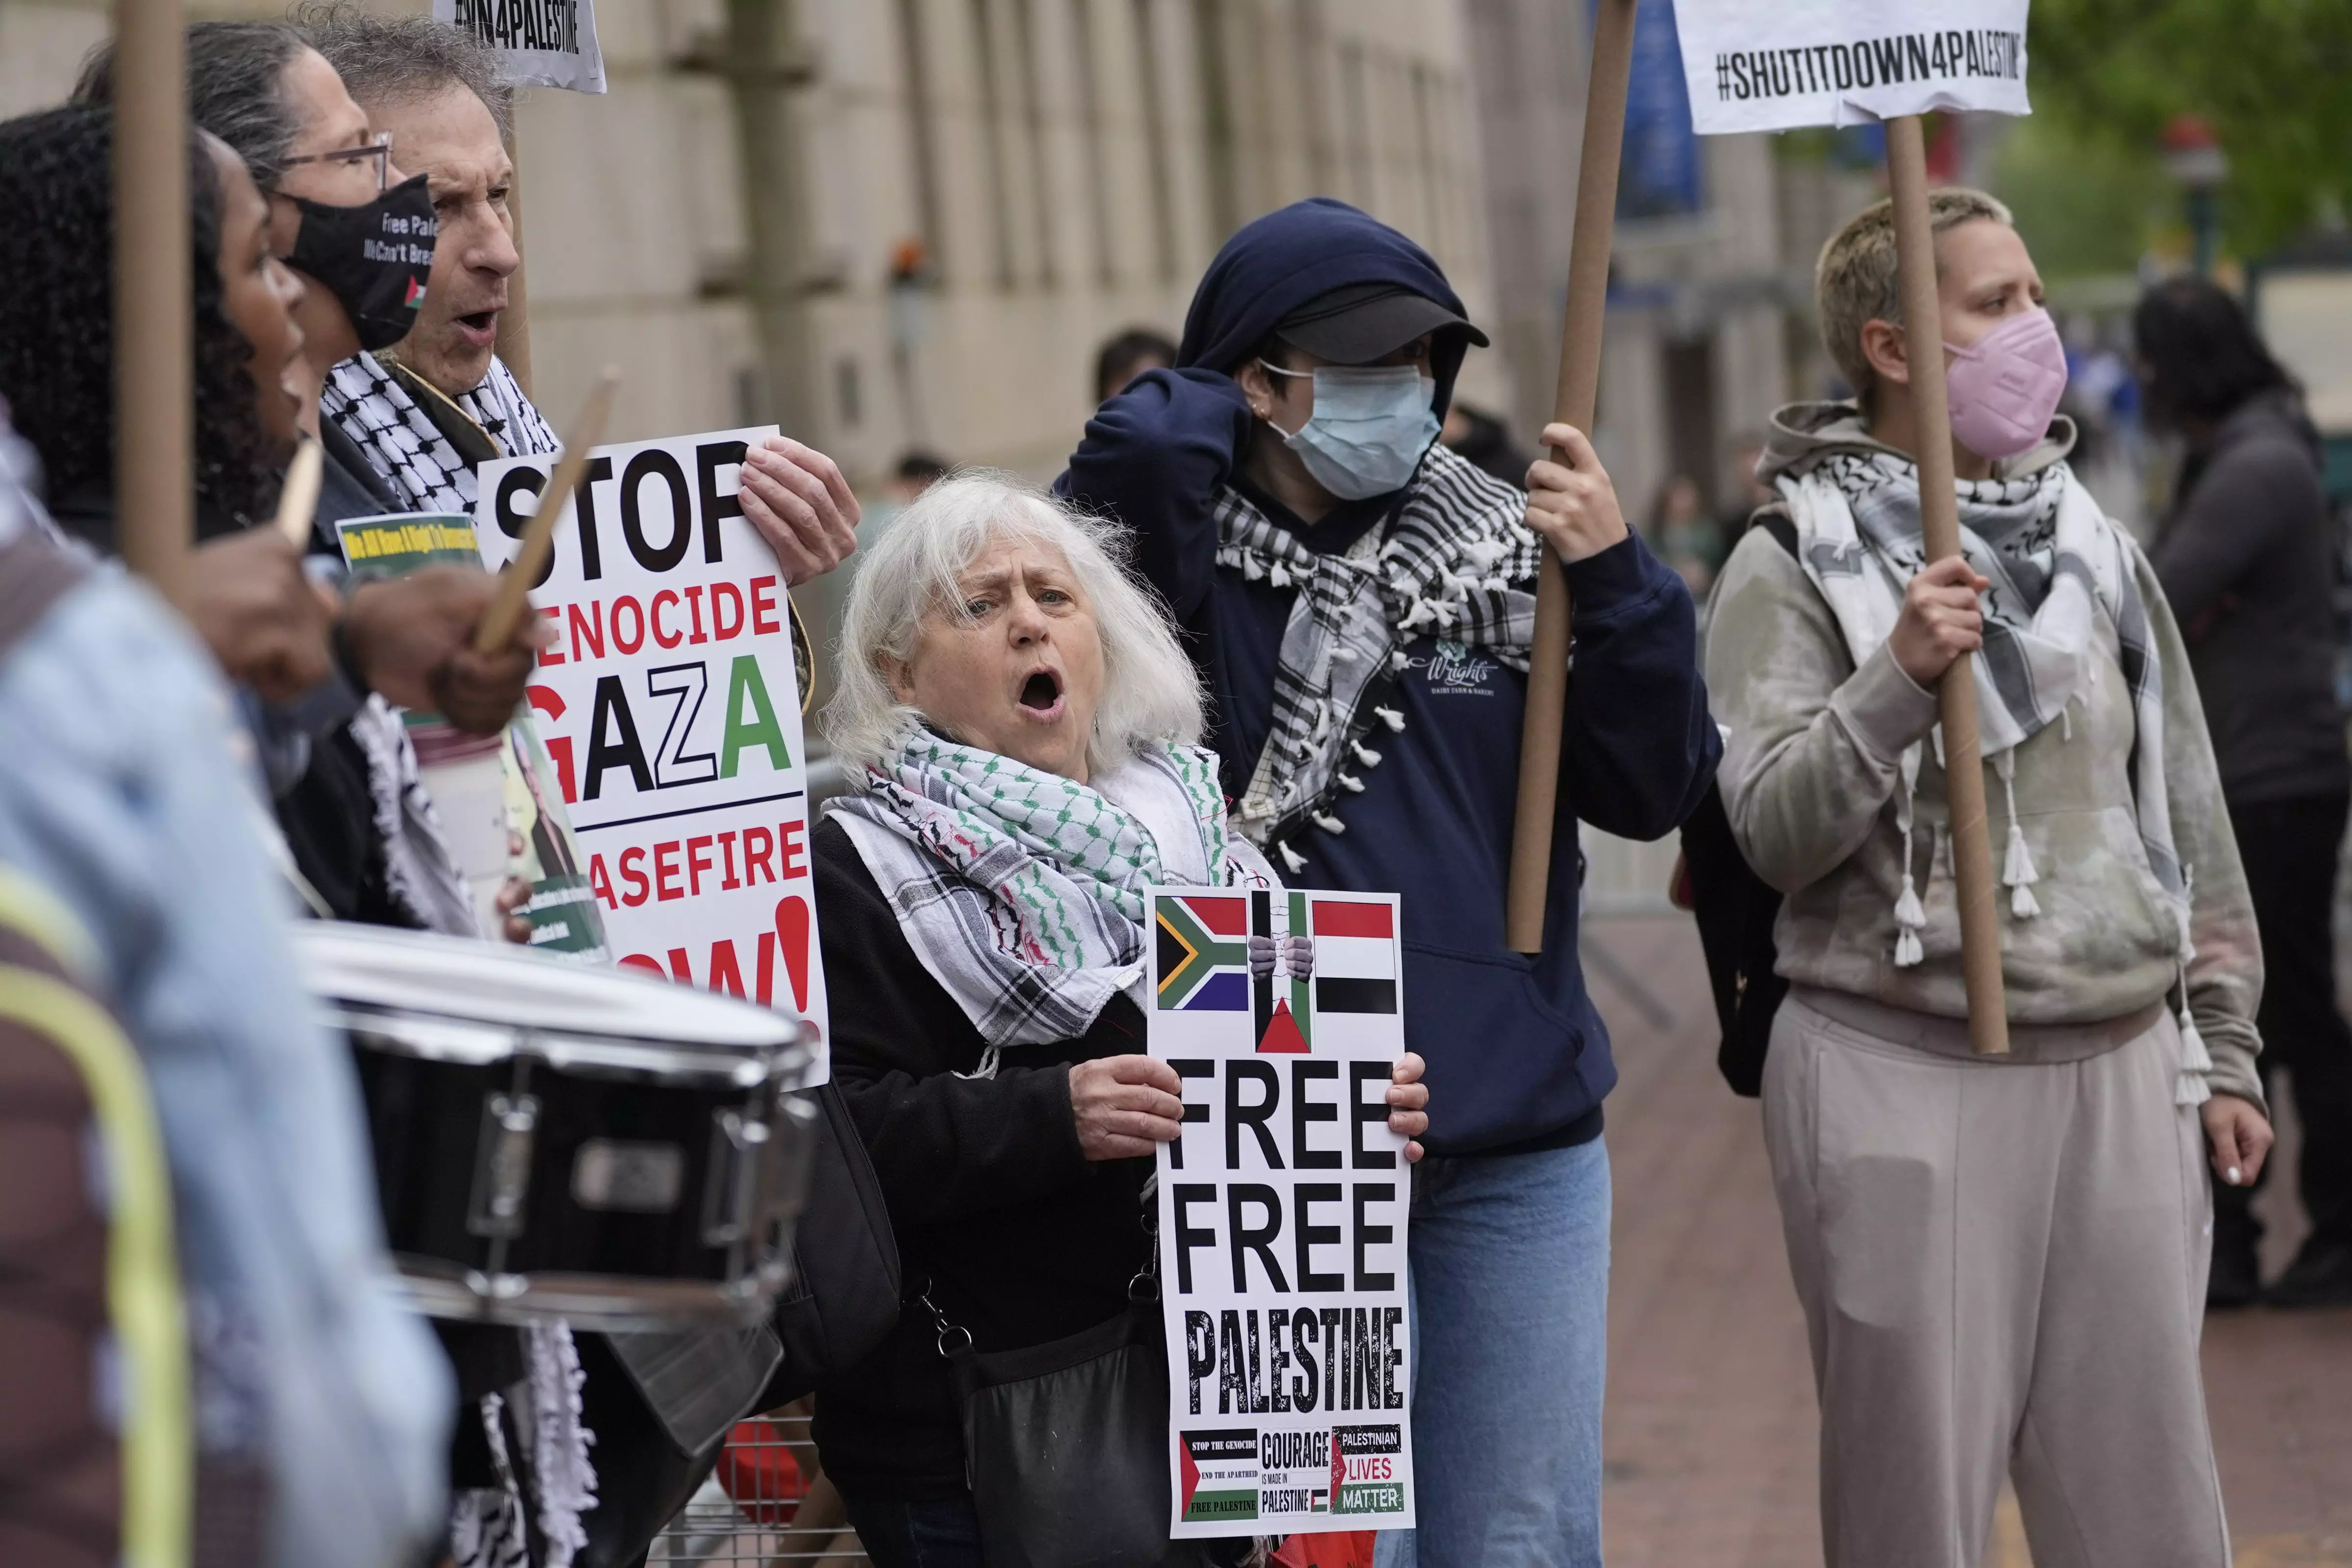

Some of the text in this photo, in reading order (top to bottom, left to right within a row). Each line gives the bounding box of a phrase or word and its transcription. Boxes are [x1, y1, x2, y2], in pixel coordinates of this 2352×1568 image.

[1716, 29, 2021, 100] #SHUTITDOWN4PALESTINE
[382, 212, 409, 234] Free
[495, 441, 750, 591] STOP
[535, 575, 781, 667] ENOCIDE
[589, 819, 808, 911] ASEFIRE
[1167, 1059, 1396, 1170] FREE
[1173, 1183, 1396, 1294] FREE
[1185, 1307, 1403, 1415] PALESTINE
[1192, 1440, 1256, 1451] STOP THE GENOCIDE
[1262, 1431, 1329, 1470] COURAGE
[1342, 1432, 1397, 1446] PALESTINIAN
[1227, 1470, 1258, 1478] APARTHEID
[1262, 1472, 1288, 1484] IS MADE IN
[1349, 1457, 1392, 1480] LIVES
[1191, 1500, 1256, 1513] FREE PALESTINE
[1262, 1489, 1308, 1513] PALESTINE
[1343, 1488, 1398, 1508] MATTER
